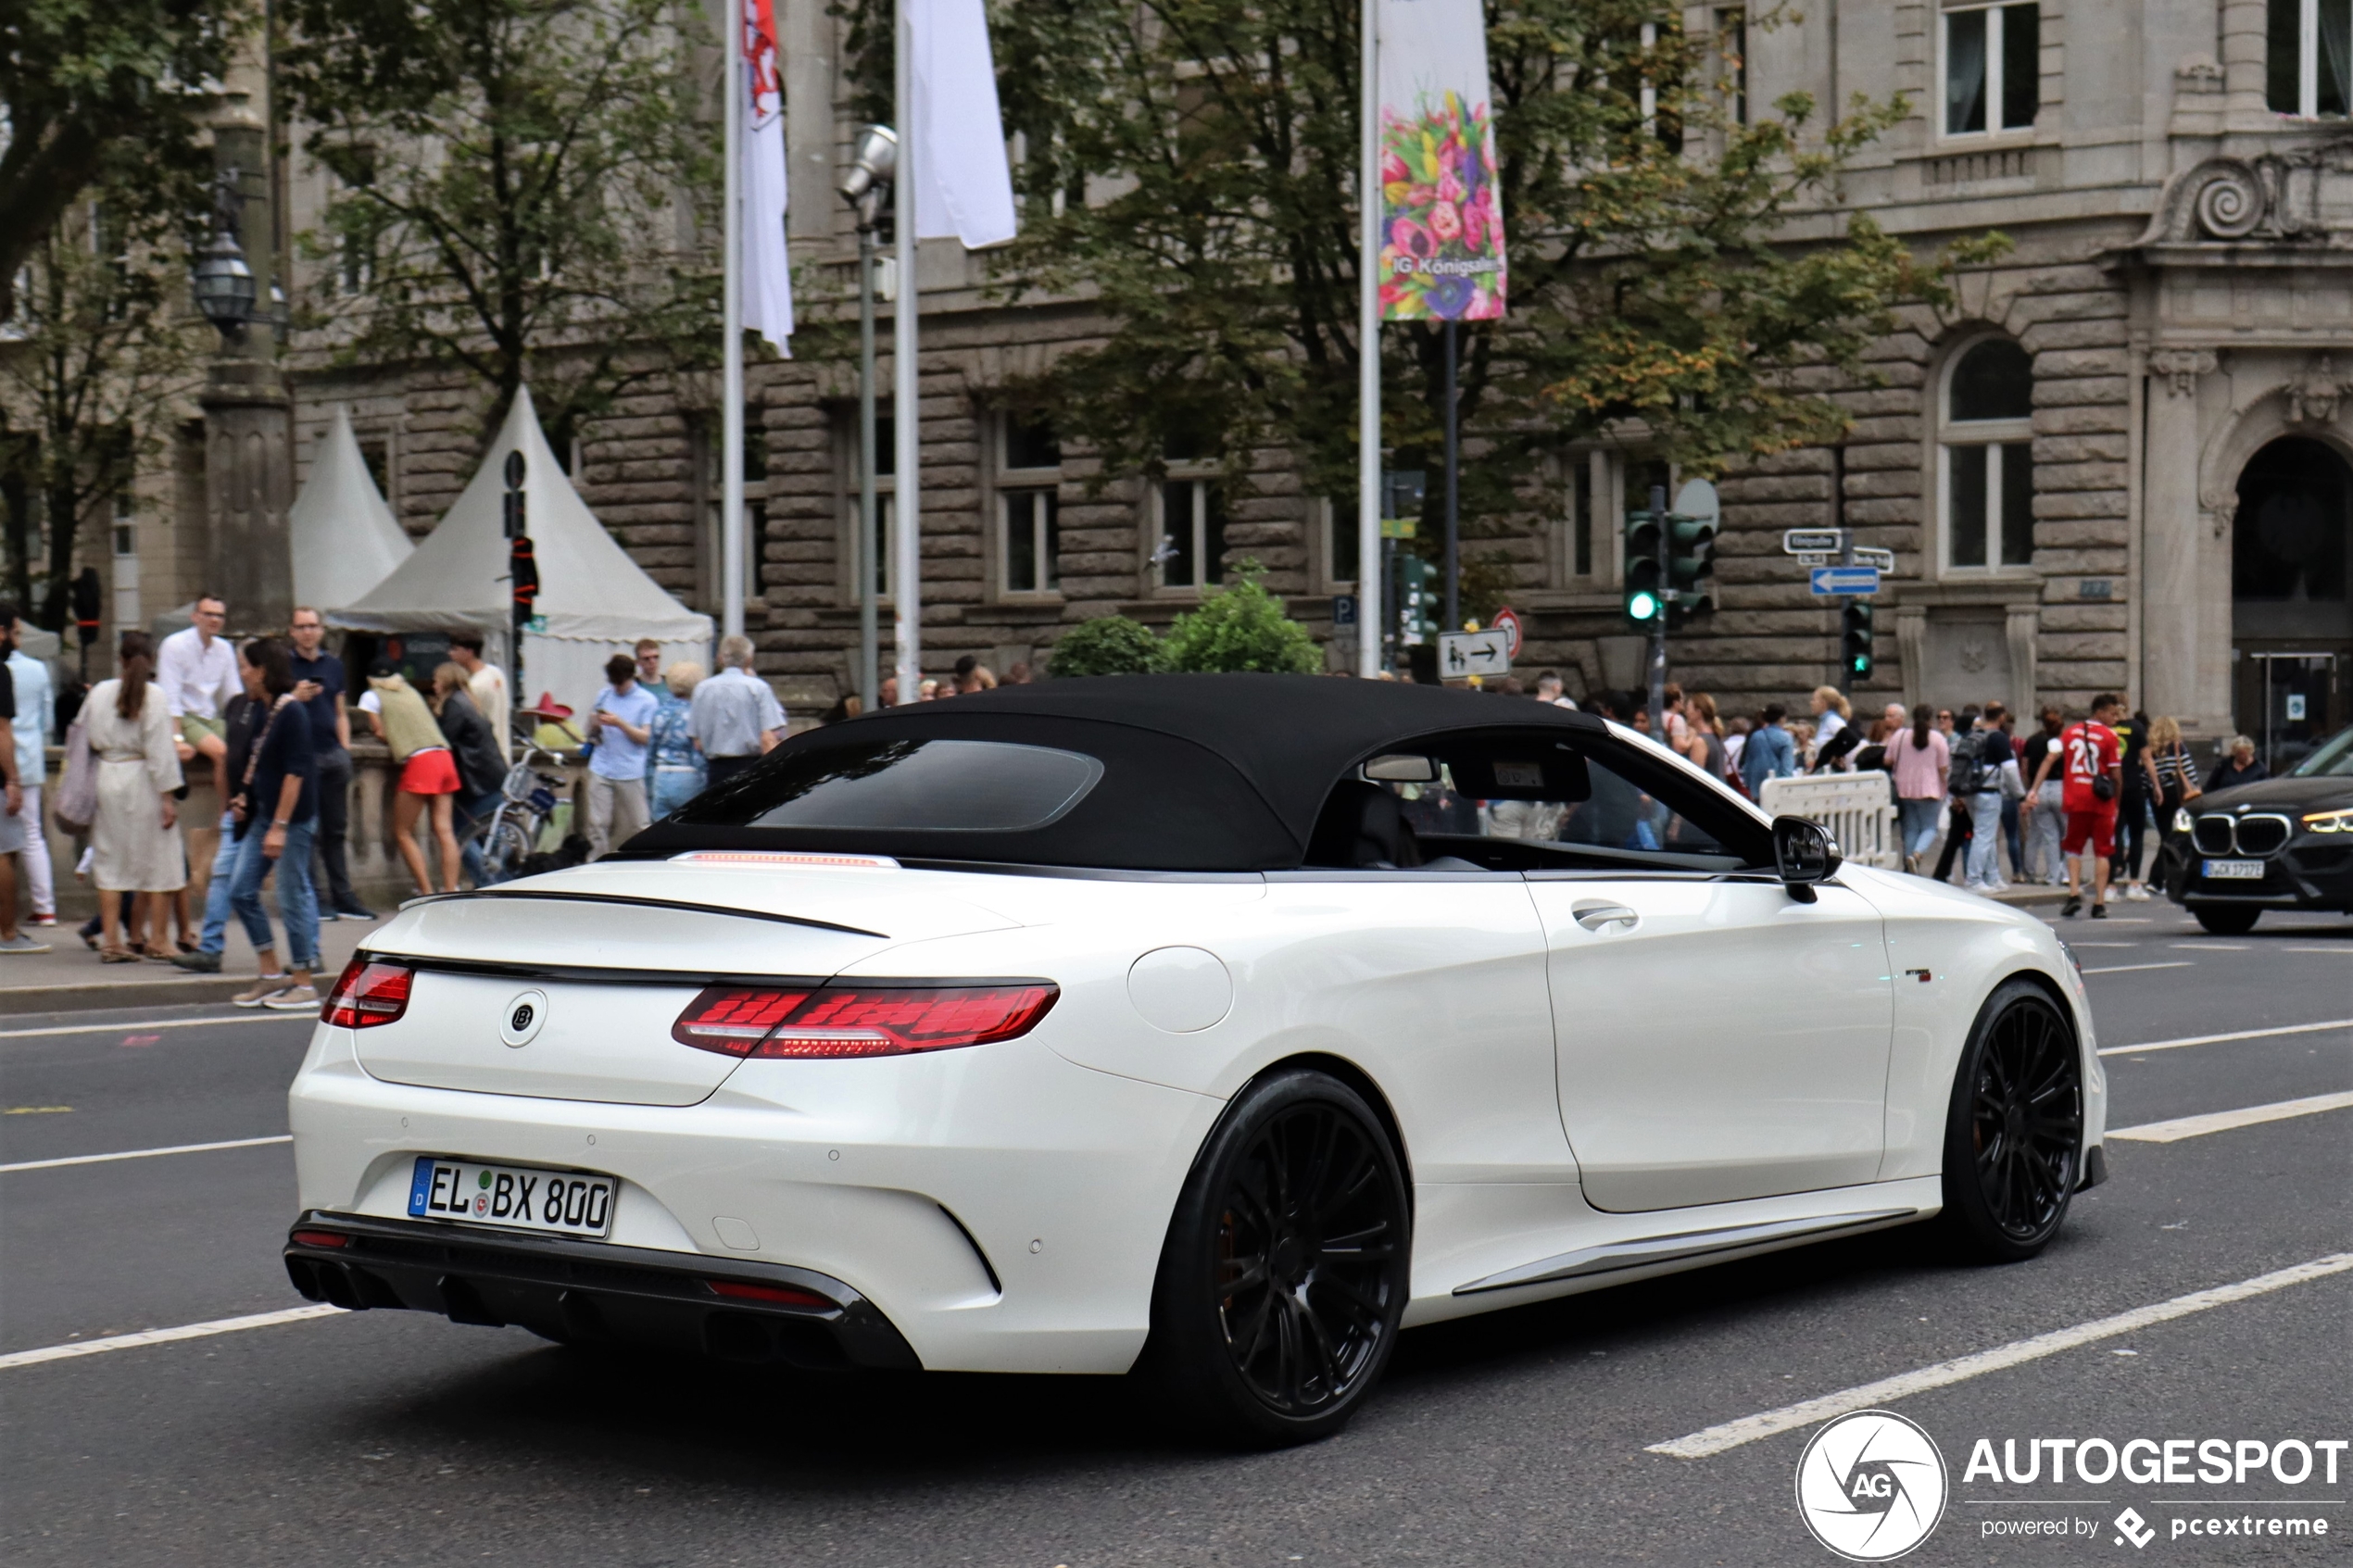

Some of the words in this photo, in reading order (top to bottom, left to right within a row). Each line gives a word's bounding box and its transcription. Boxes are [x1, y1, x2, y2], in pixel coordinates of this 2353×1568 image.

[1394, 257, 1414, 273] IG
[428, 1167, 470, 1213] EL
[491, 1173, 538, 1221] BX
[543, 1178, 609, 1229] 800
